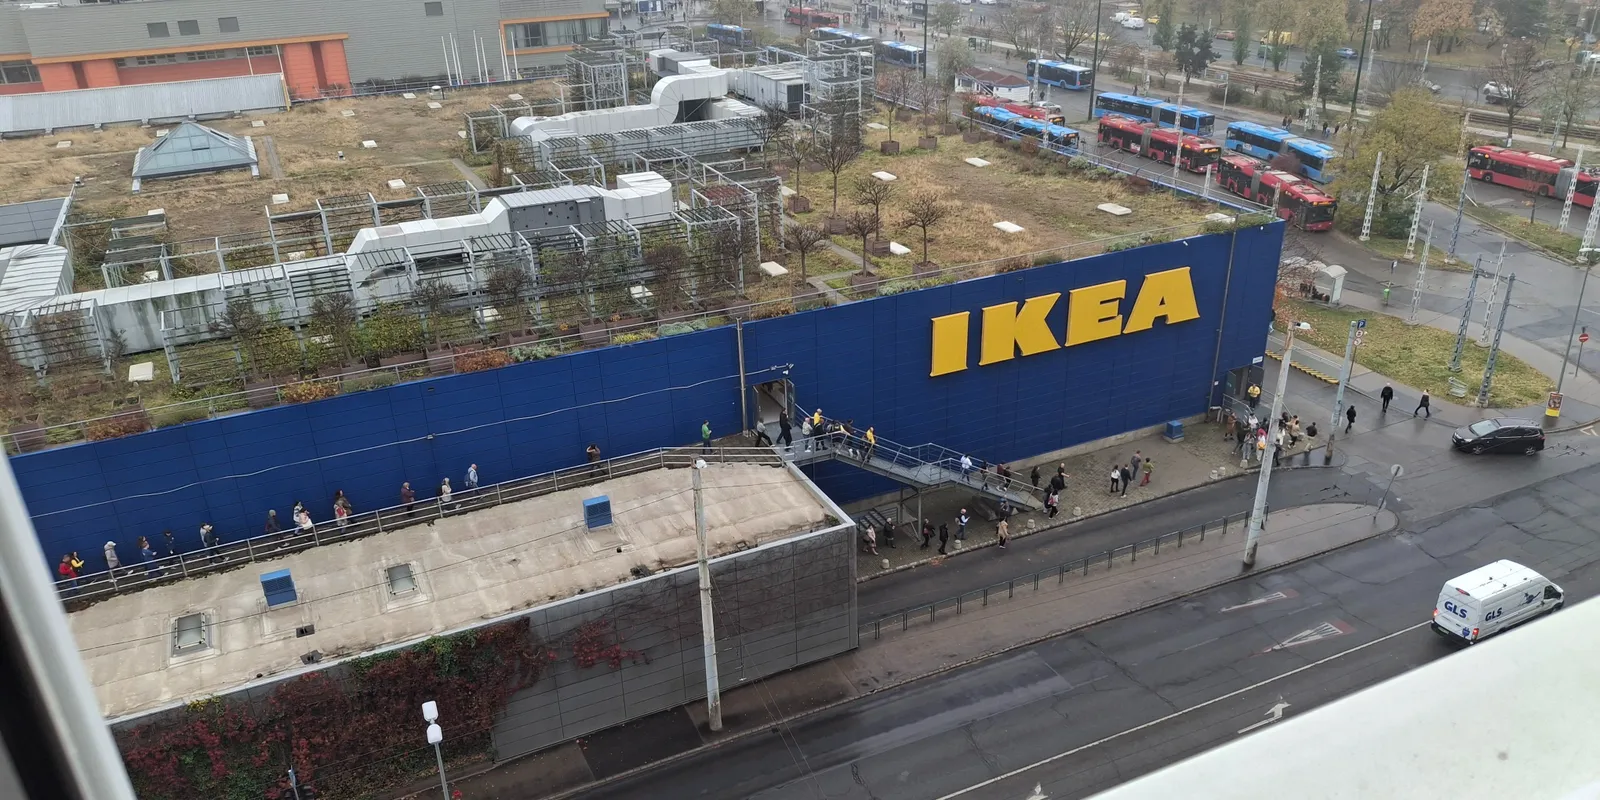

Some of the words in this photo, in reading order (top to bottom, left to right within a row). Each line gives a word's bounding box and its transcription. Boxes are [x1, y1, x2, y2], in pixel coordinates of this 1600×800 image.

[930, 266, 1200, 377] IKEA
[1444, 601, 1468, 619] GLS
[1485, 607, 1503, 621] GLS
